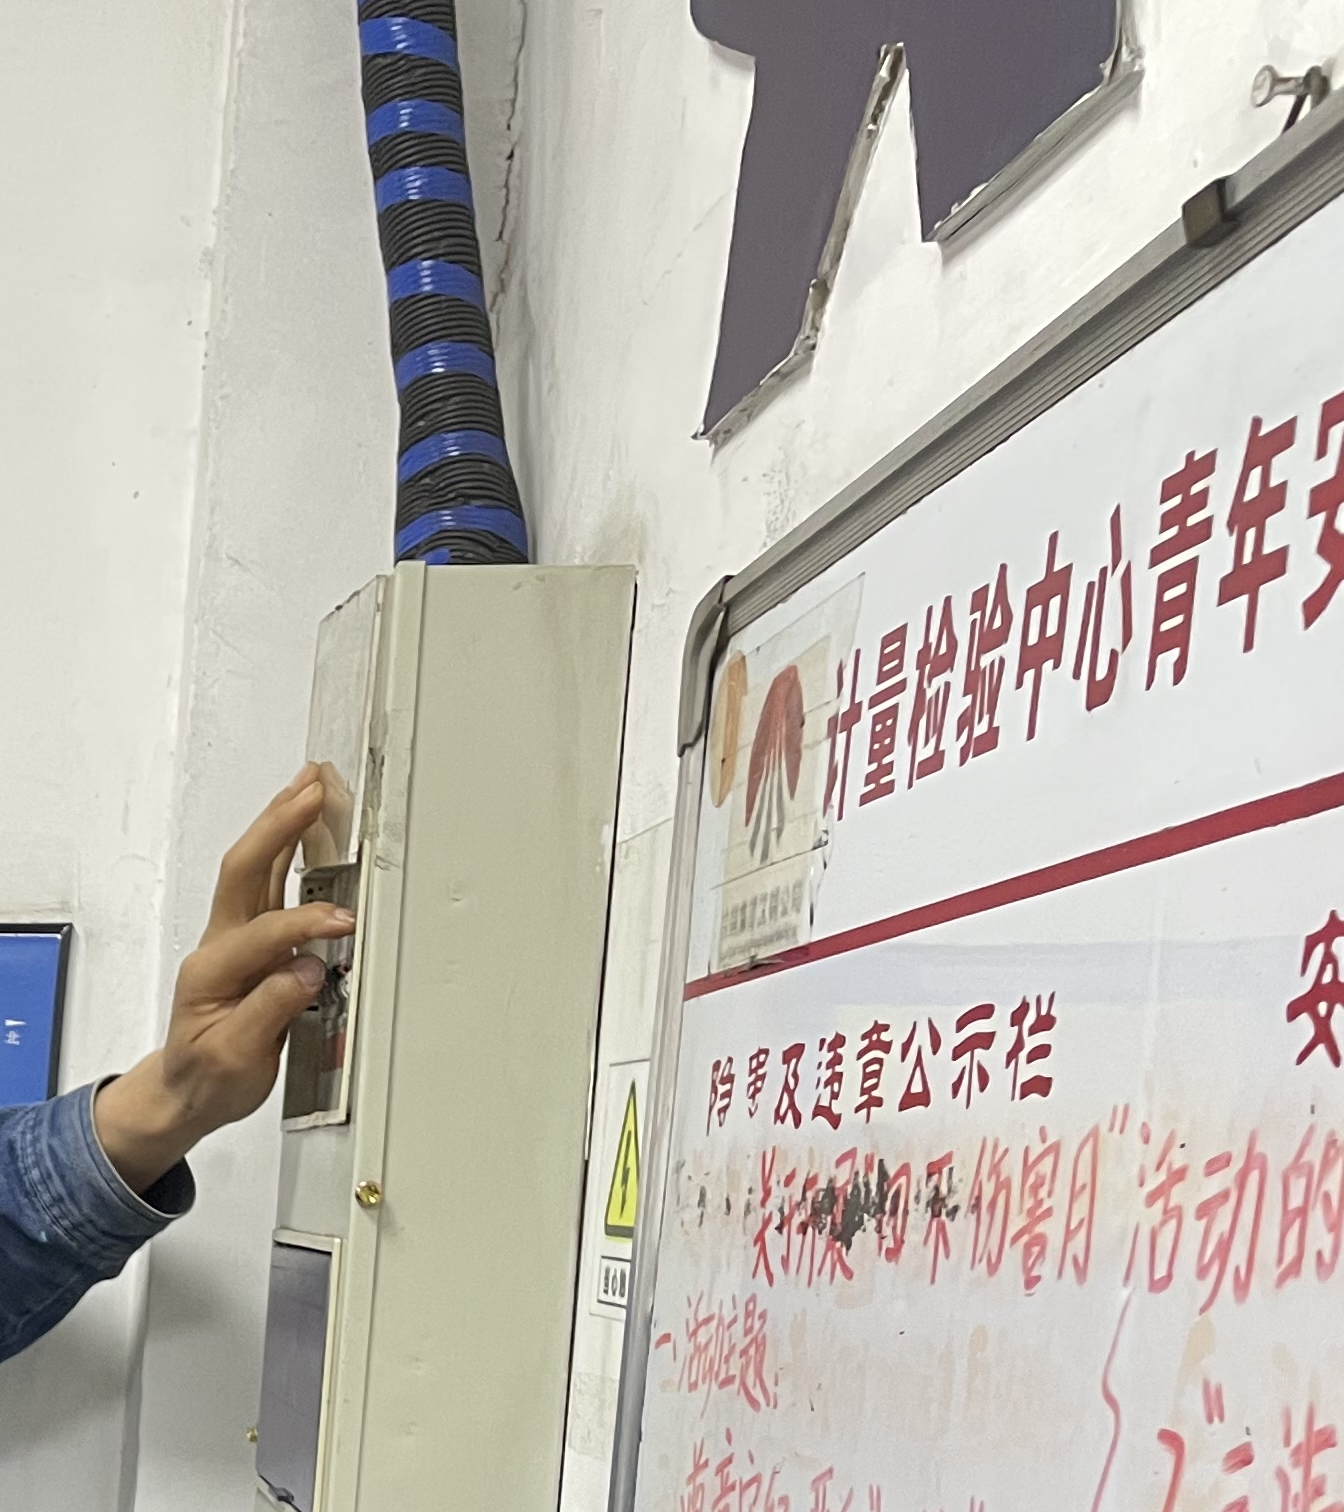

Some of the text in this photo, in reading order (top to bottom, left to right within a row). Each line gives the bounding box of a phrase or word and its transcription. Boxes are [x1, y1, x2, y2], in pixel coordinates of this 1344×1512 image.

[706, 990, 1057, 1136] 隐患及违章公示栏
